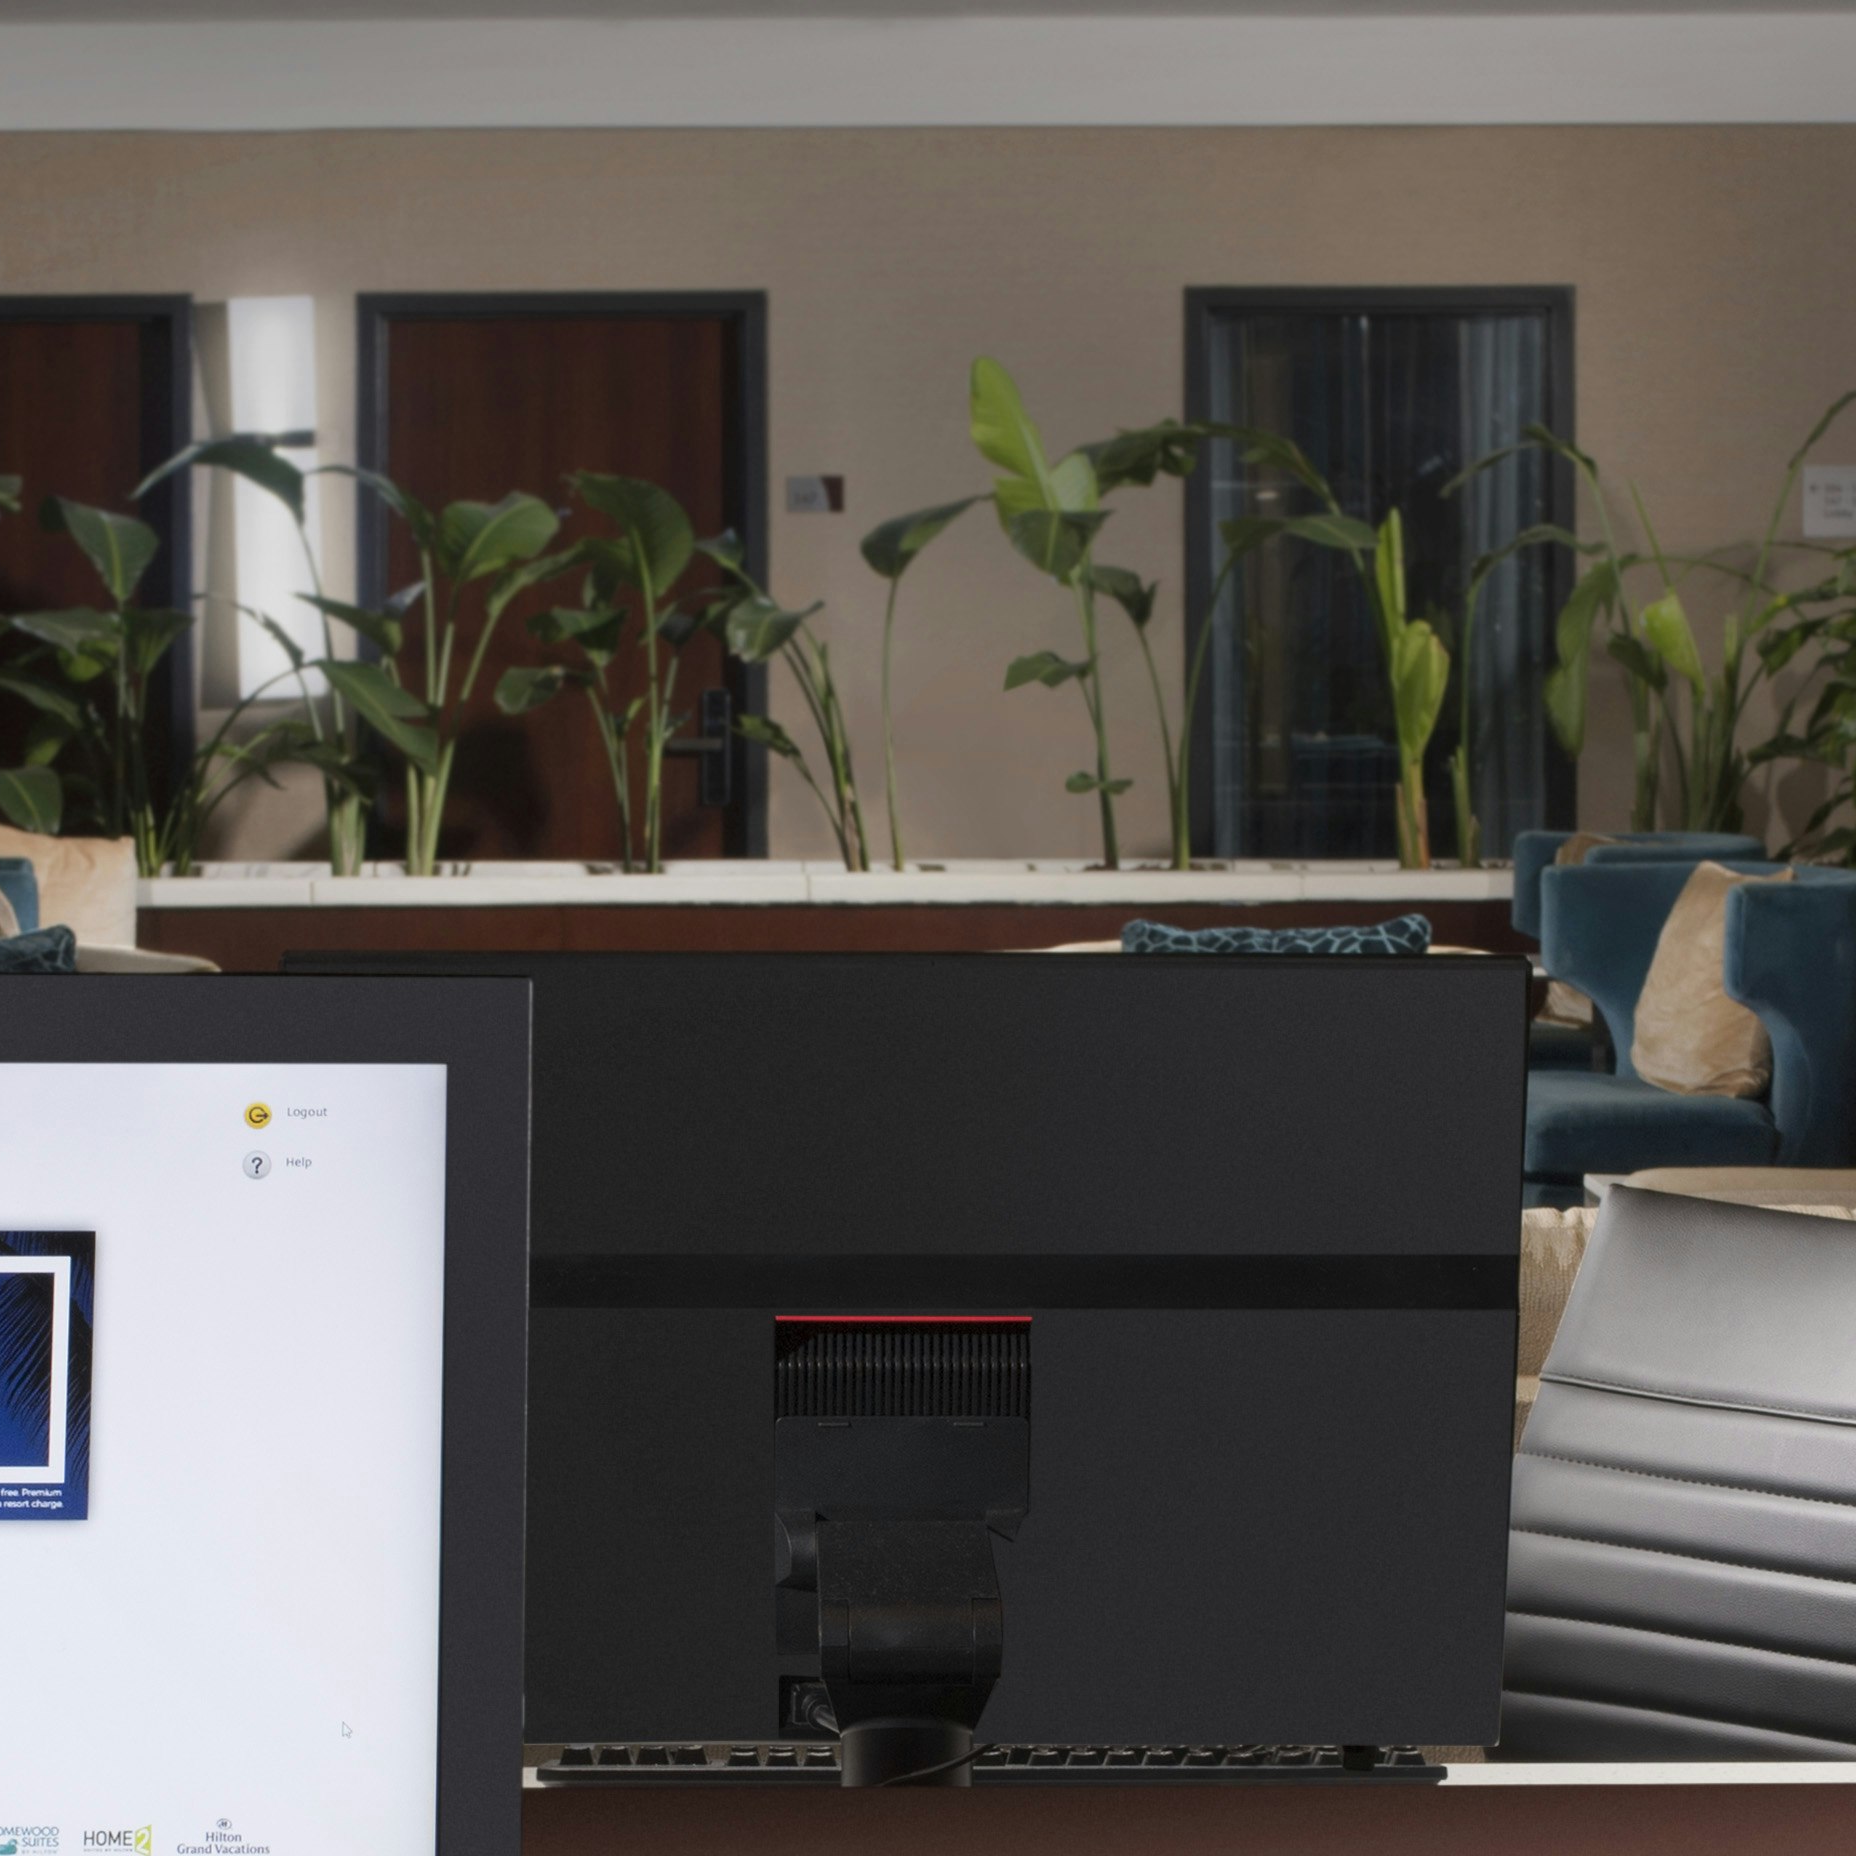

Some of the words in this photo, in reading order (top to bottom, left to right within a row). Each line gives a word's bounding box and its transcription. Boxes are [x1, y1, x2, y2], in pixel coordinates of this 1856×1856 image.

[287, 1107, 327, 1119] Logout
[286, 1157, 312, 1169] Help
[22, 1488, 62, 1496] Premium
[4, 1500, 29, 1508] resort
[205, 1831, 242, 1842] Hilton
[21, 1837, 59, 1847] SUITES
[177, 1844, 212, 1854] Grand
[215, 1844, 270, 1854] Vacations
